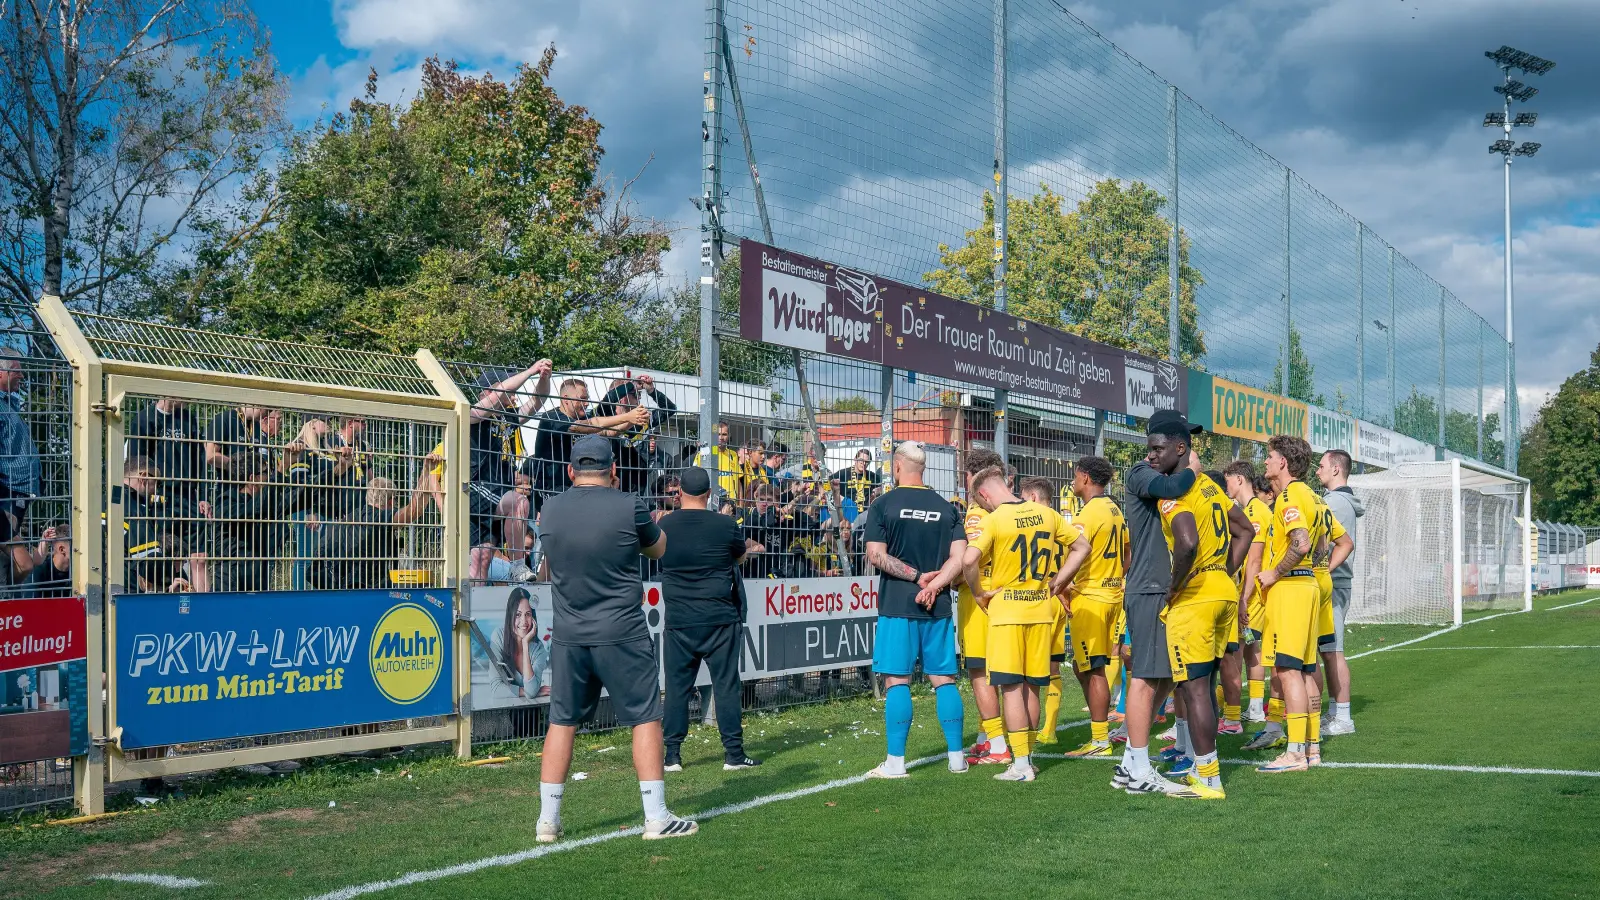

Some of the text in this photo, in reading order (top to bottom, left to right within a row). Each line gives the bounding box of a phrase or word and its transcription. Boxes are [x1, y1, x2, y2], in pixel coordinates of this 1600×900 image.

[762, 252, 827, 282] Bestattermeister
[769, 287, 871, 350] Würdinger
[902, 305, 1114, 385] Der Trauer Raum und Zeit geben.
[954, 360, 1081, 398] www.wuerdinger-bestattungen.de
[1215, 386, 1306, 438] TORTECHNIK
[1313, 412, 1353, 454] HEINEN
[900, 508, 941, 523] cep
[1014, 514, 1044, 529] ZIETSCH
[1212, 503, 1229, 556] 9
[1010, 531, 1051, 582] 16
[765, 583, 843, 616] Klemens
[0, 630, 72, 657] tellung!
[129, 626, 360, 677] PKW+LKW
[374, 630, 437, 659] Muhr
[376, 658, 435, 673] AUTOVERLEIH
[147, 668, 344, 705] zum Mini-Tarif
